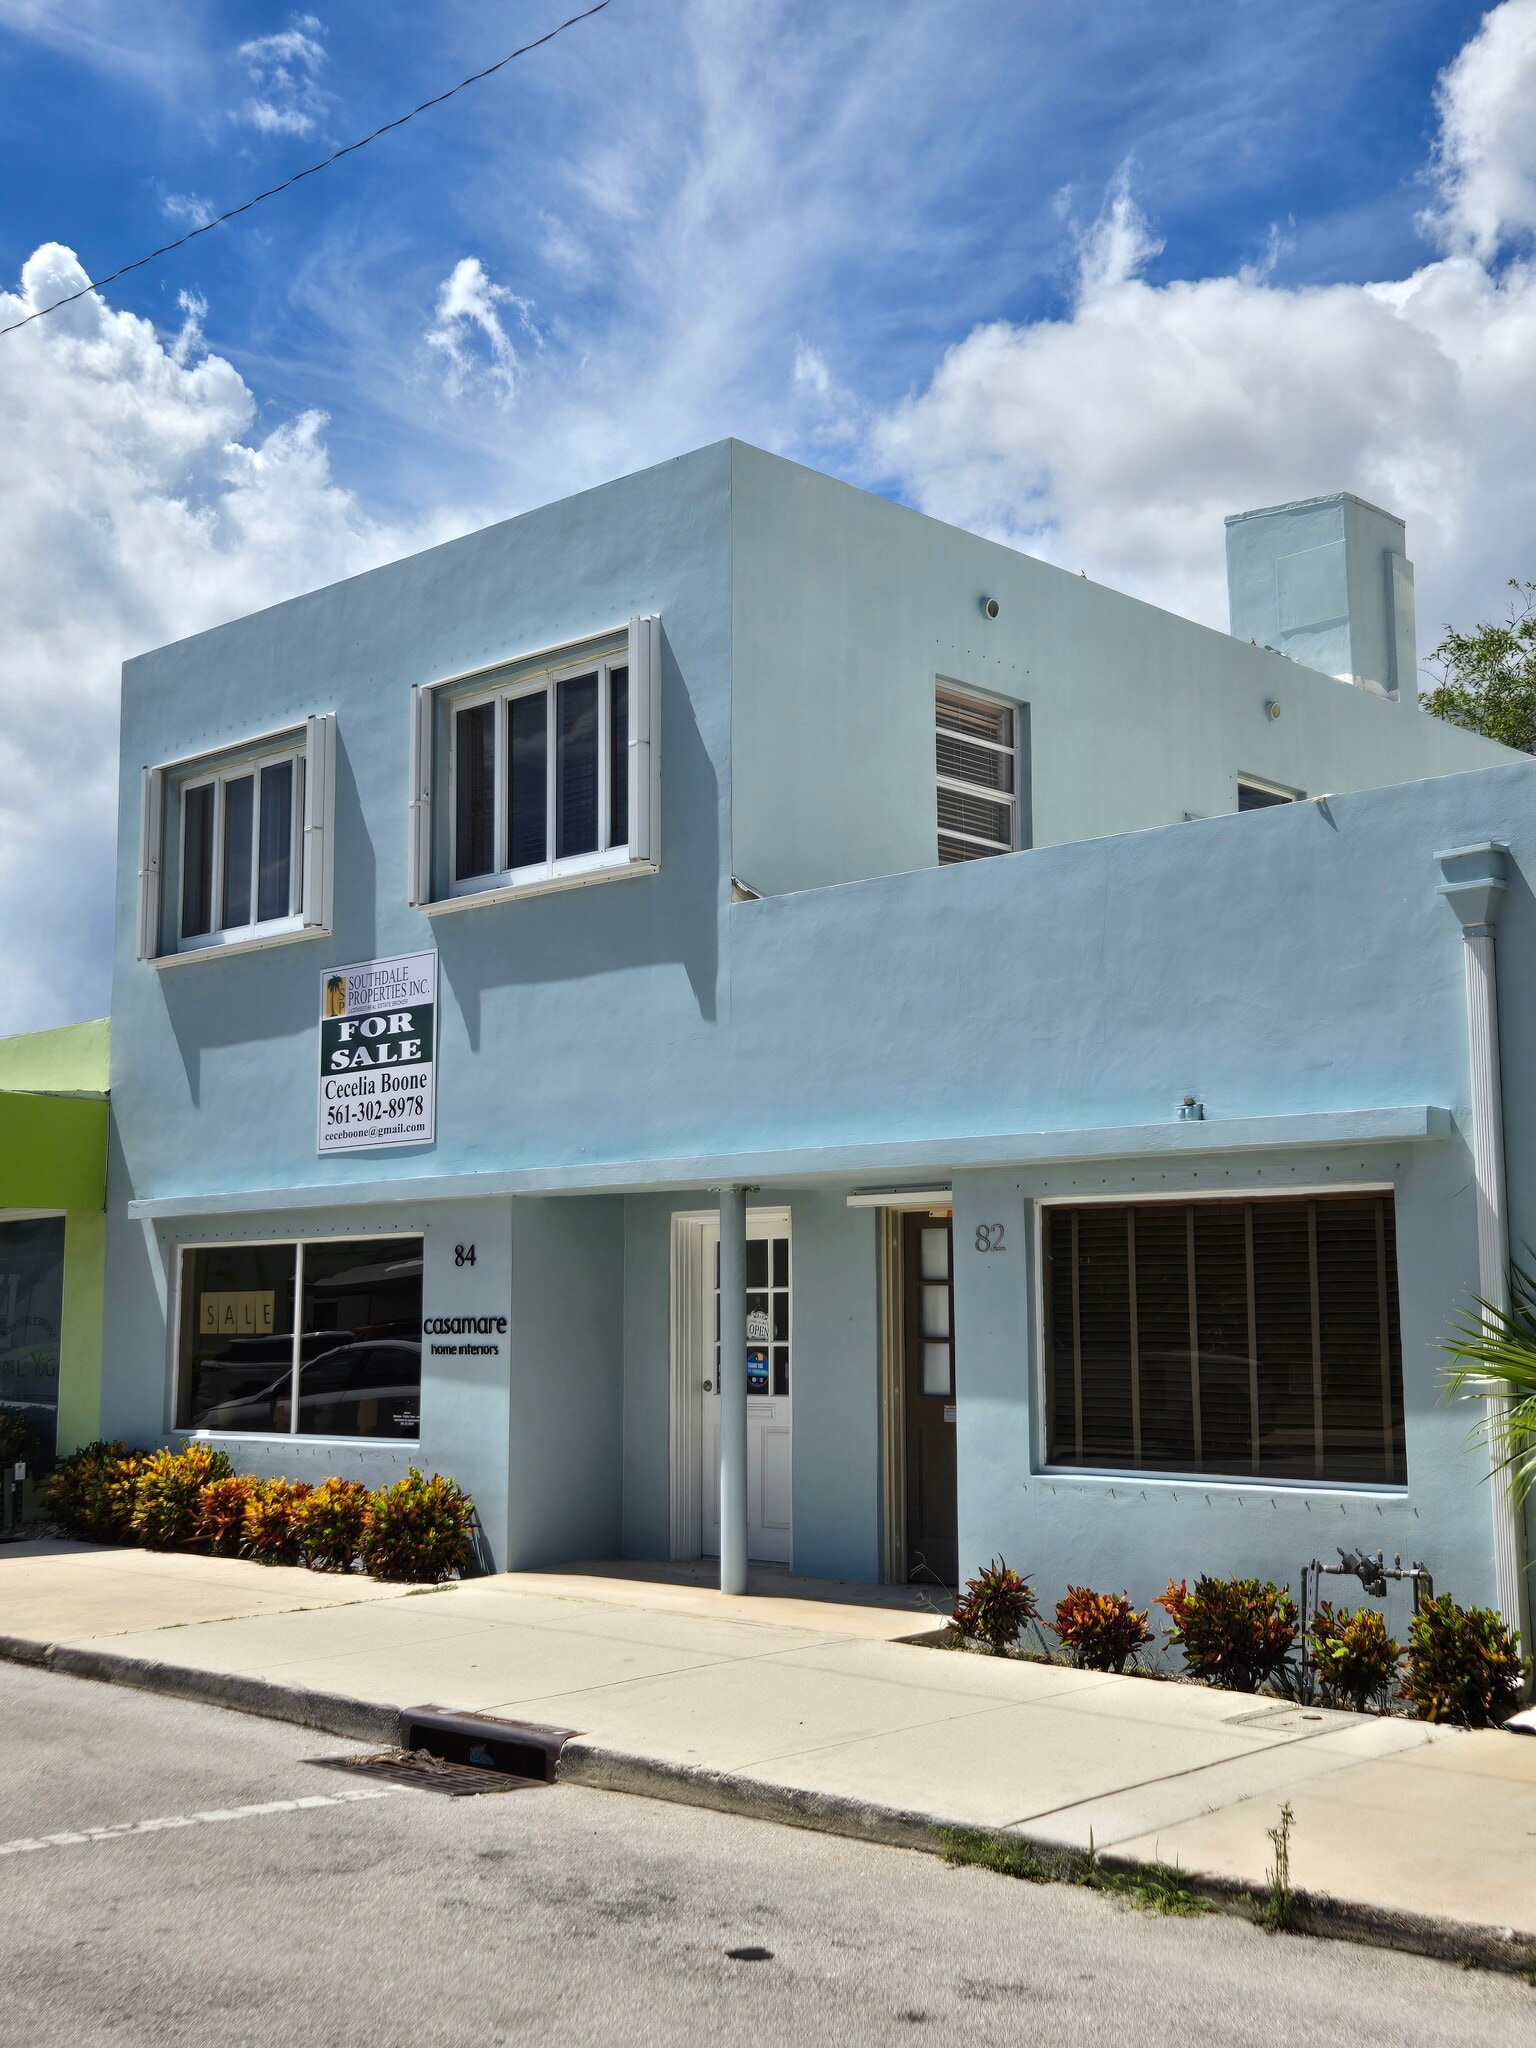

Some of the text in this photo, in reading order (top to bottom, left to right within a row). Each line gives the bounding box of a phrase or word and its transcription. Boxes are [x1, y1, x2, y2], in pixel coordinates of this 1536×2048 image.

[349, 966, 409, 991] SOUTHDALE
[348, 979, 430, 1006] PROPERTIES INC.
[338, 1013, 415, 1041] FOR
[331, 1039, 421, 1070] SALE
[326, 1073, 427, 1099] Cecelia Boone
[328, 1095, 423, 1125] 561-302-8978
[325, 1123, 425, 1140] ceceboone@gmail.com
[974, 1223, 1006, 1252] 82
[454, 1244, 477, 1267] 84
[207, 1304, 271, 1325] SALE
[424, 1316, 507, 1334] casamare
[749, 1323, 769, 1337] OPEN
[431, 1344, 499, 1355] home interiors
